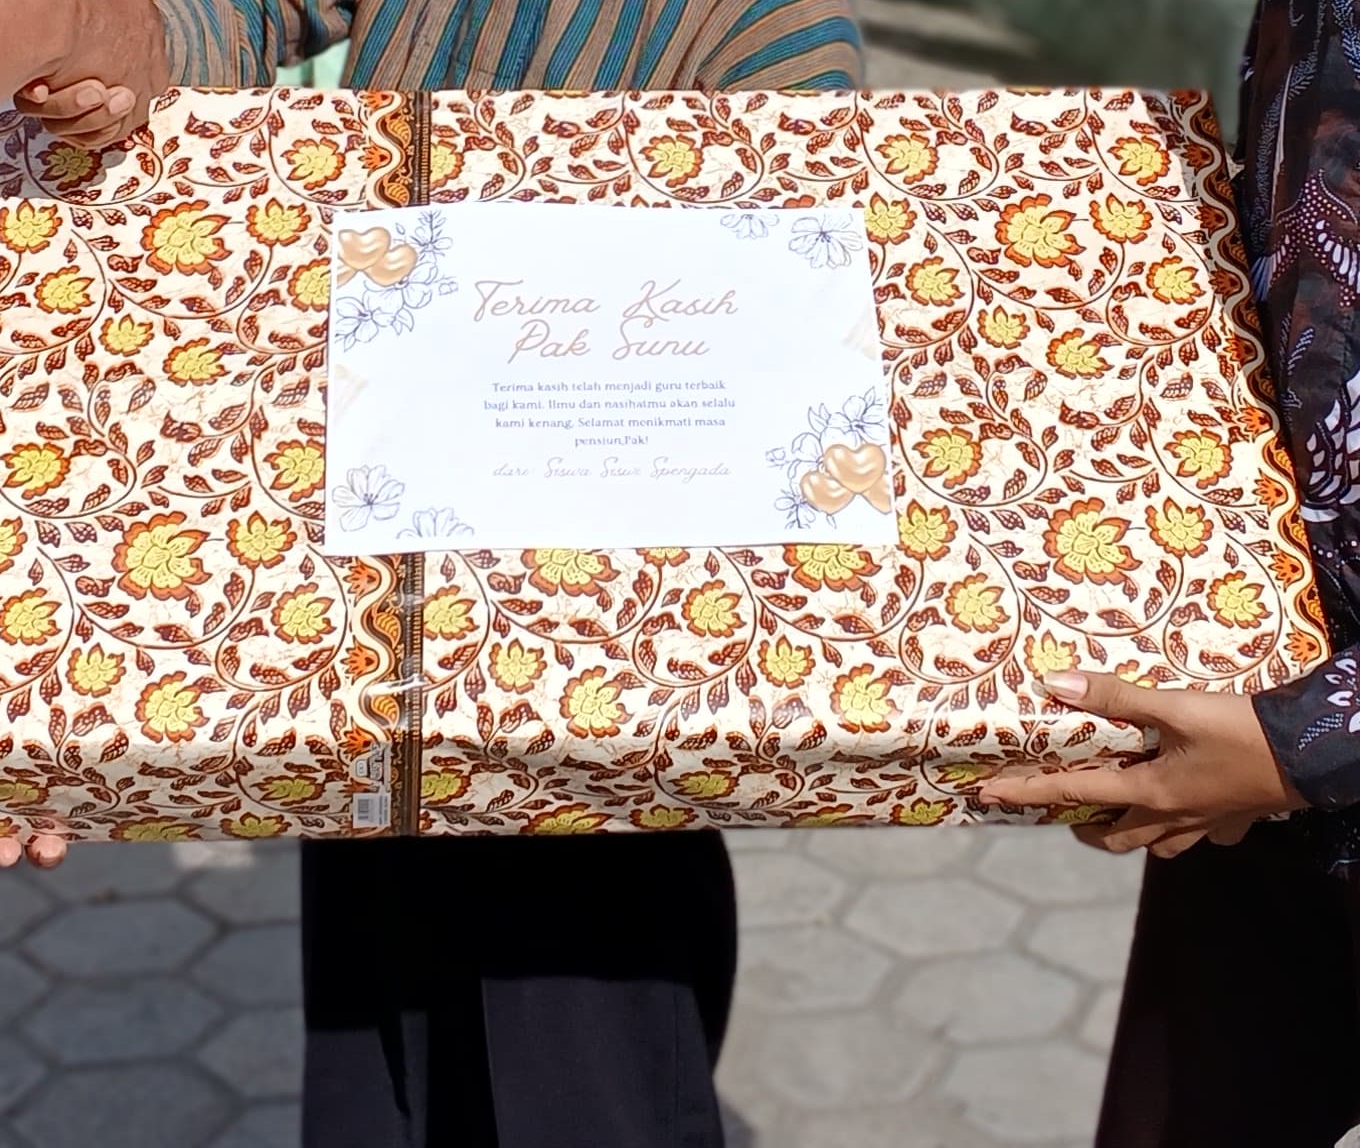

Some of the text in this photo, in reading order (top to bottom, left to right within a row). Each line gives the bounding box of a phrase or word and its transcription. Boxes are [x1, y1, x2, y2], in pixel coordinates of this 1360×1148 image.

[474, 278, 738, 322] Terima Kasih
[507, 315, 710, 364] Pak Sunu
[492, 380, 727, 394] Terima kasih telah menjadi guru terbaik
[483, 400, 509, 412] bagi
[578, 399, 601, 410] dan
[701, 398, 736, 409] selalu
[578, 417, 625, 429] Selamat
[694, 418, 726, 428] masa
